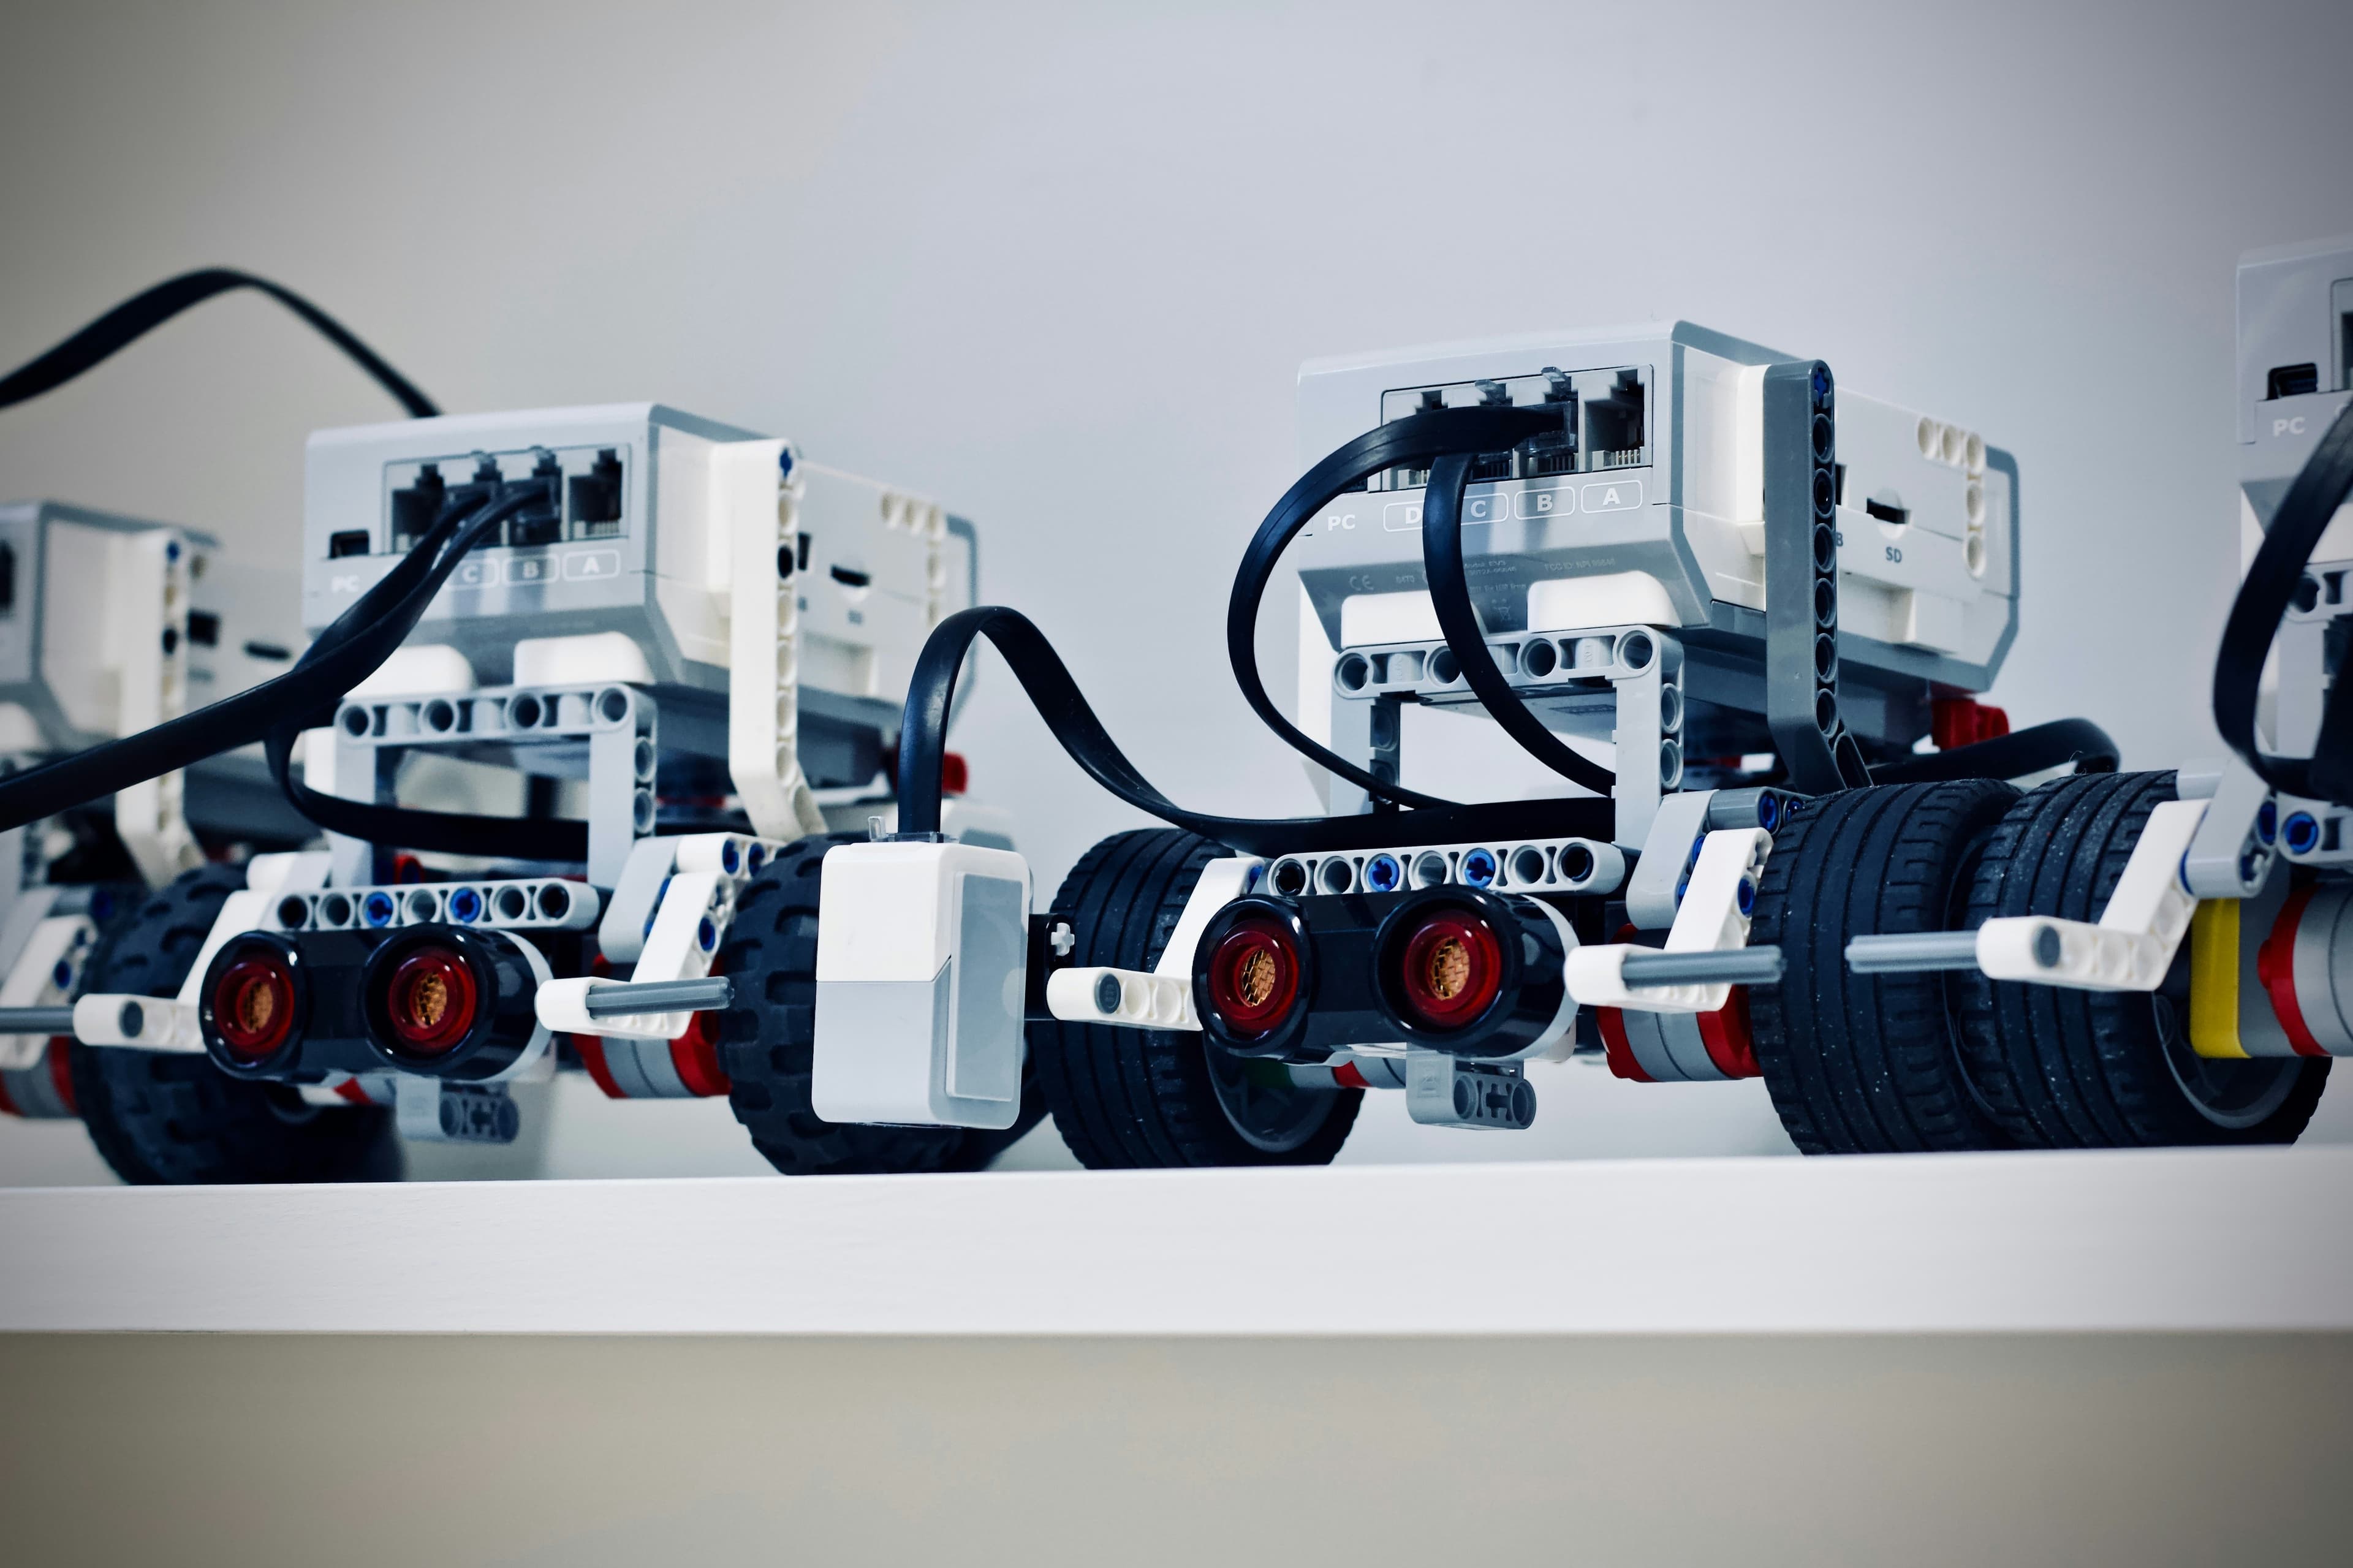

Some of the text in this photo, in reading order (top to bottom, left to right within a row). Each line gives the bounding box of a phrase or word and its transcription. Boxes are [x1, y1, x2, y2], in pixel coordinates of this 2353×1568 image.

[2273, 417, 2306, 437] PC
[1328, 488, 1621, 531] PC D C B A
[1885, 547, 1903, 563] SD
[332, 556, 600, 594] PC C B A
